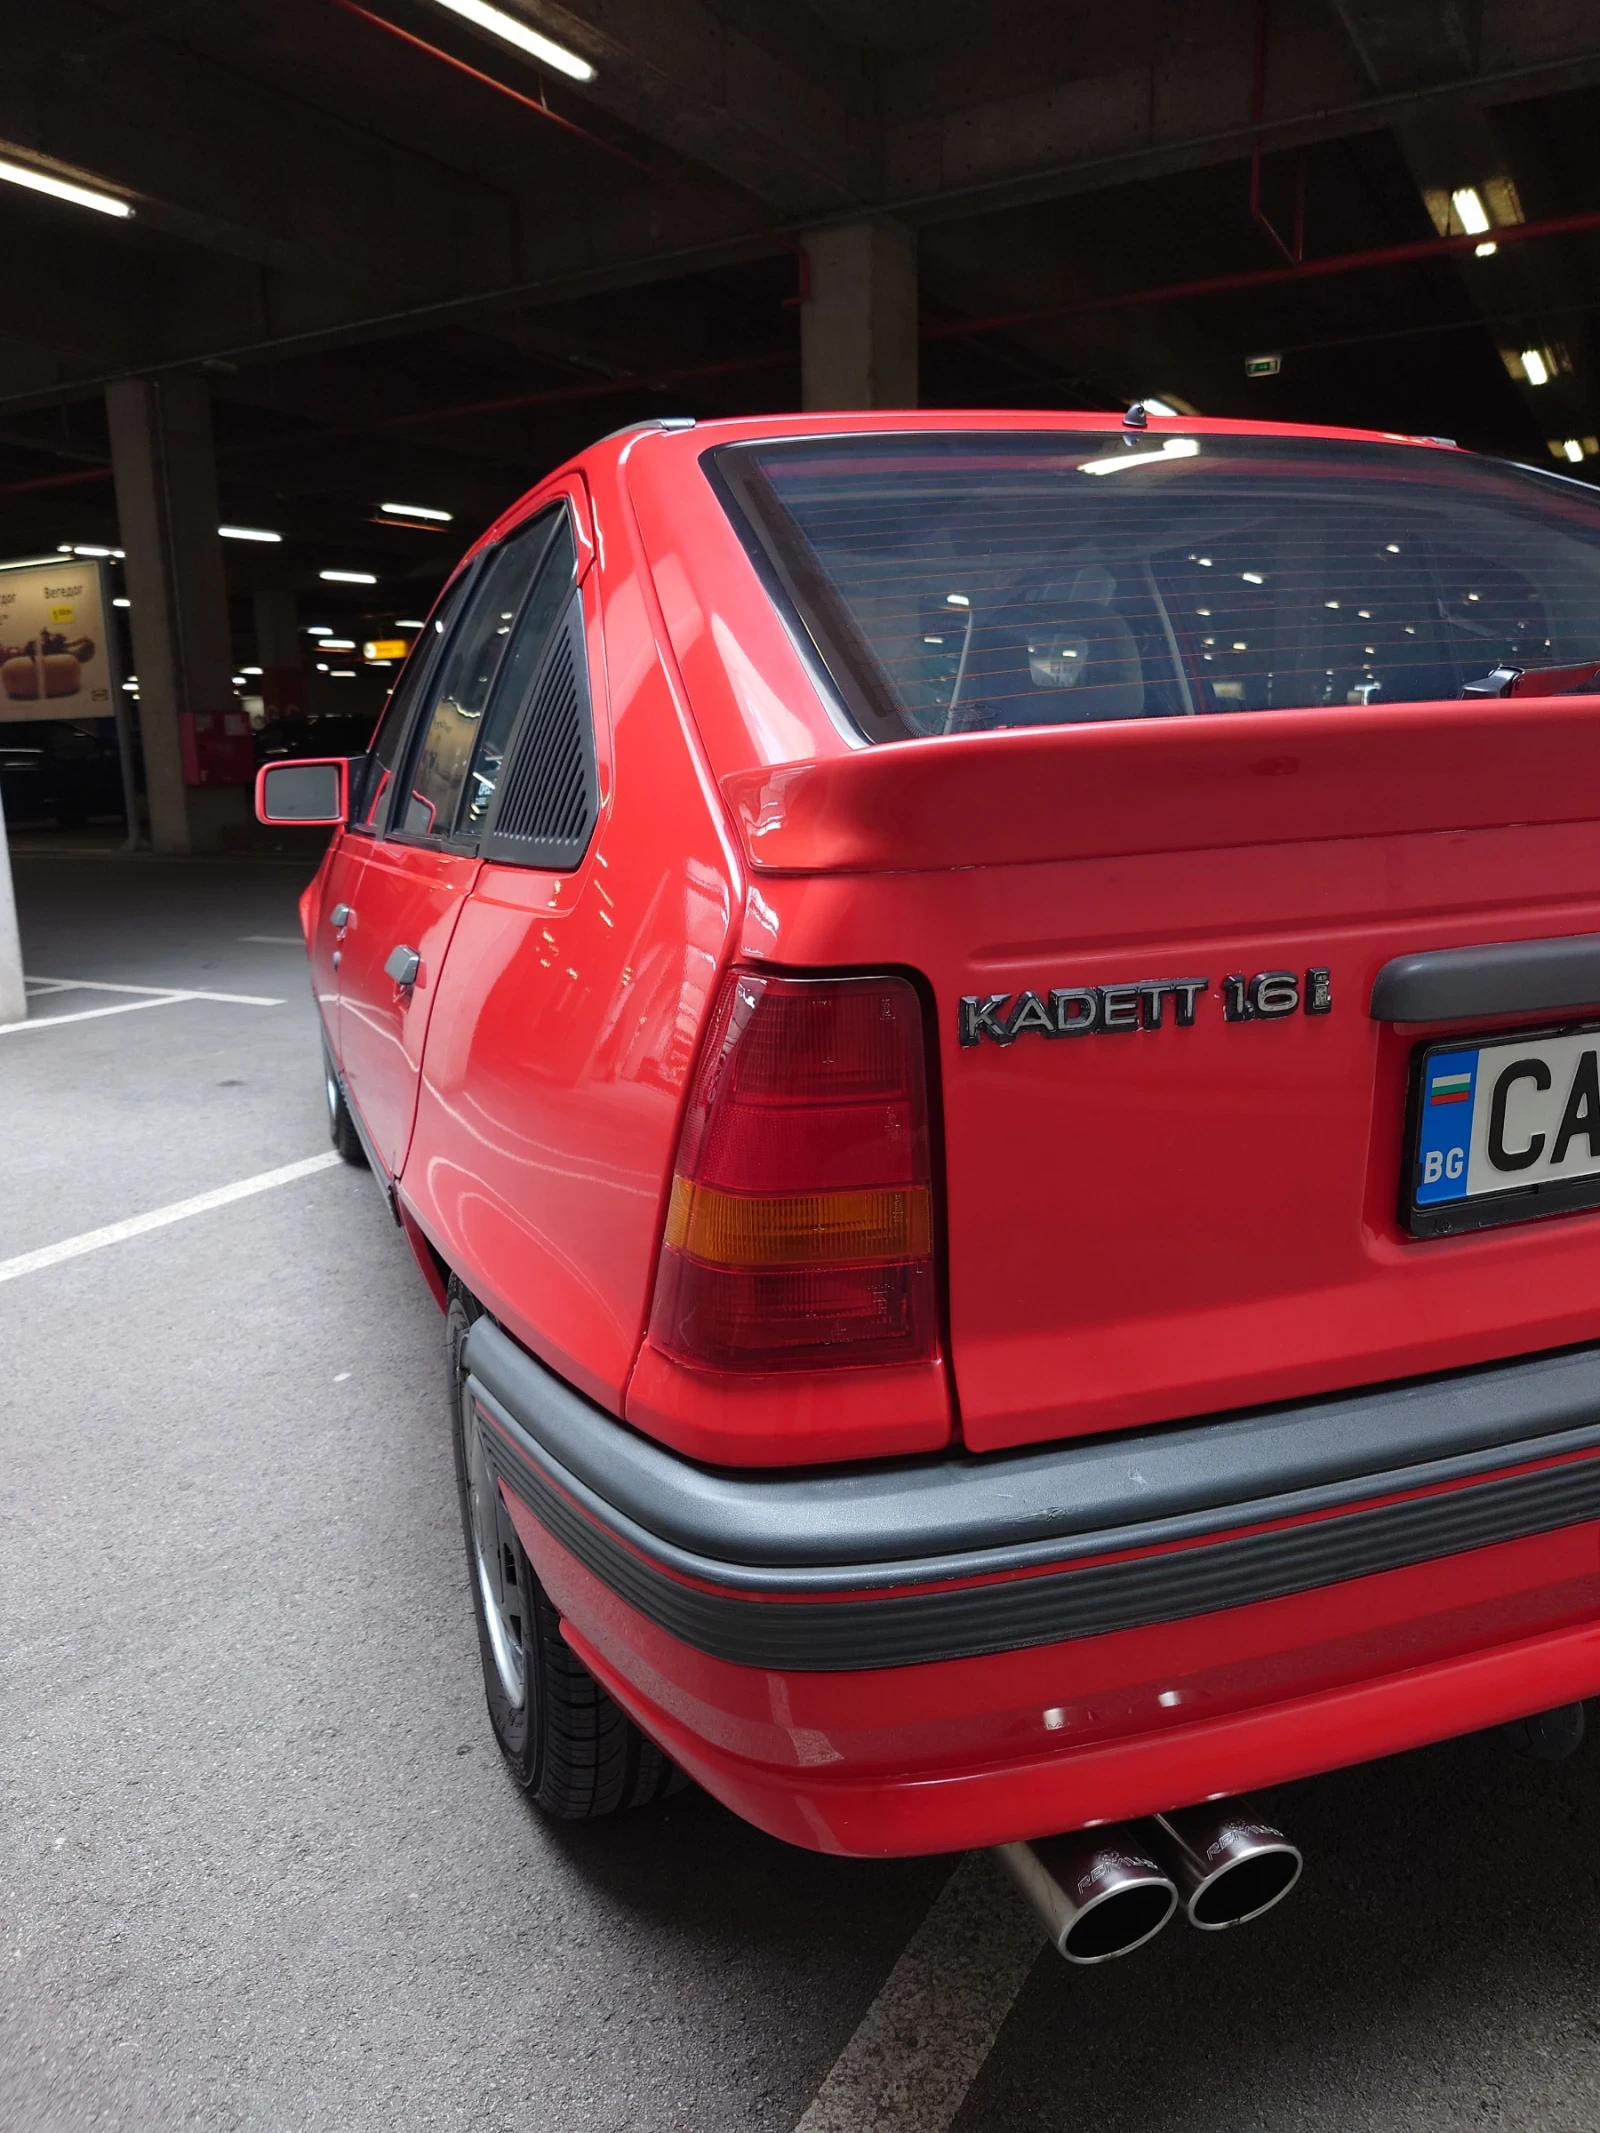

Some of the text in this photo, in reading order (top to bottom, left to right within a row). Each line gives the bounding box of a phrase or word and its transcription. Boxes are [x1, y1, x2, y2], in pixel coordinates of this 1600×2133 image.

[960, 977, 1208, 1047] KADETT
[1223, 974, 1299, 1022] 1.6
[1488, 1050, 1600, 1172] CA
[1424, 1147, 1464, 1185] BG
